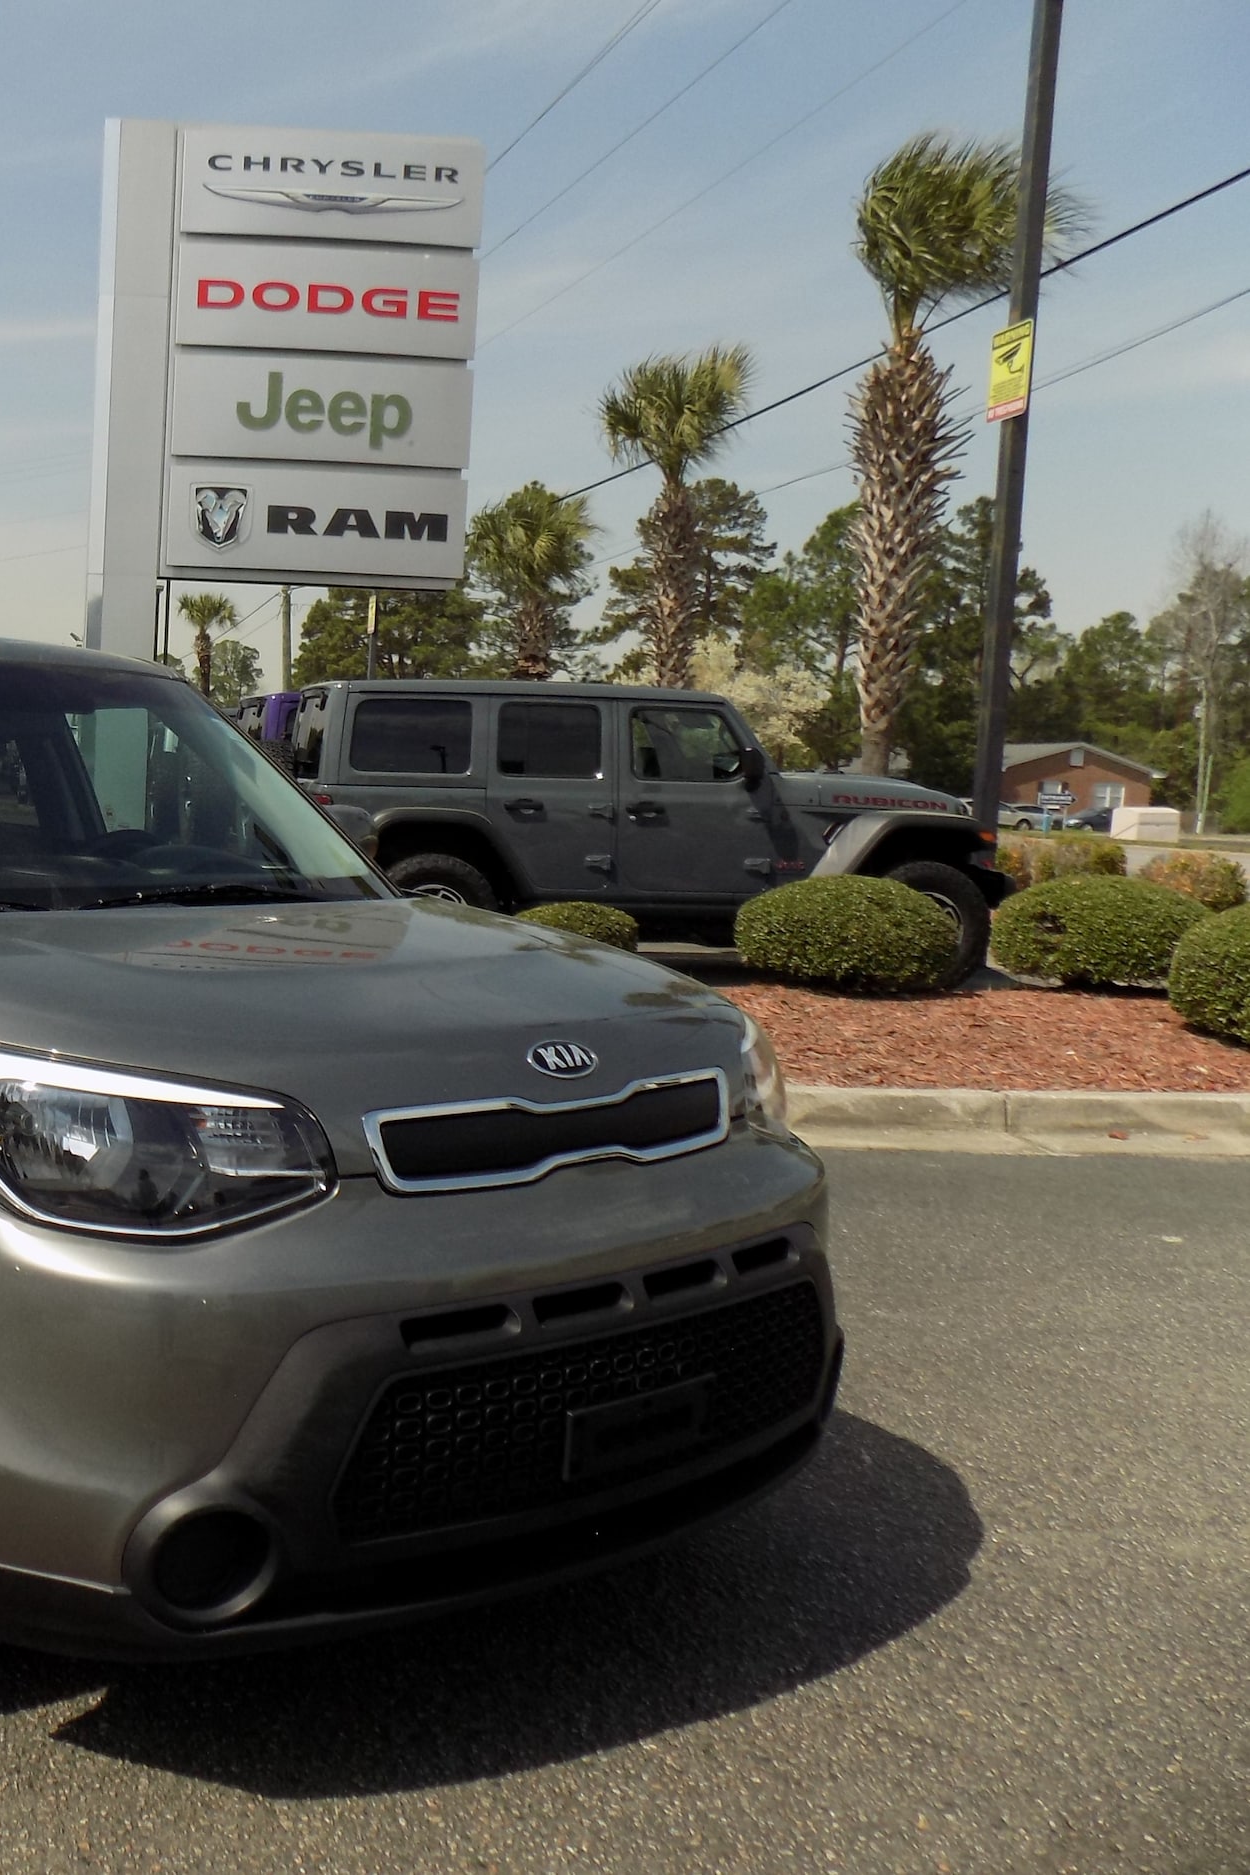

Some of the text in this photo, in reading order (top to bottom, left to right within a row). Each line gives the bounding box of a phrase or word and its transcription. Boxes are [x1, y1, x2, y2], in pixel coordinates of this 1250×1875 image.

[207, 154, 459, 185] CHRYSLER
[197, 279, 460, 322] DODGE
[236, 371, 413, 449] Jeep
[266, 505, 448, 542] RAM
[831, 794, 948, 812] RUBICON
[536, 1044, 592, 1071] KIA
